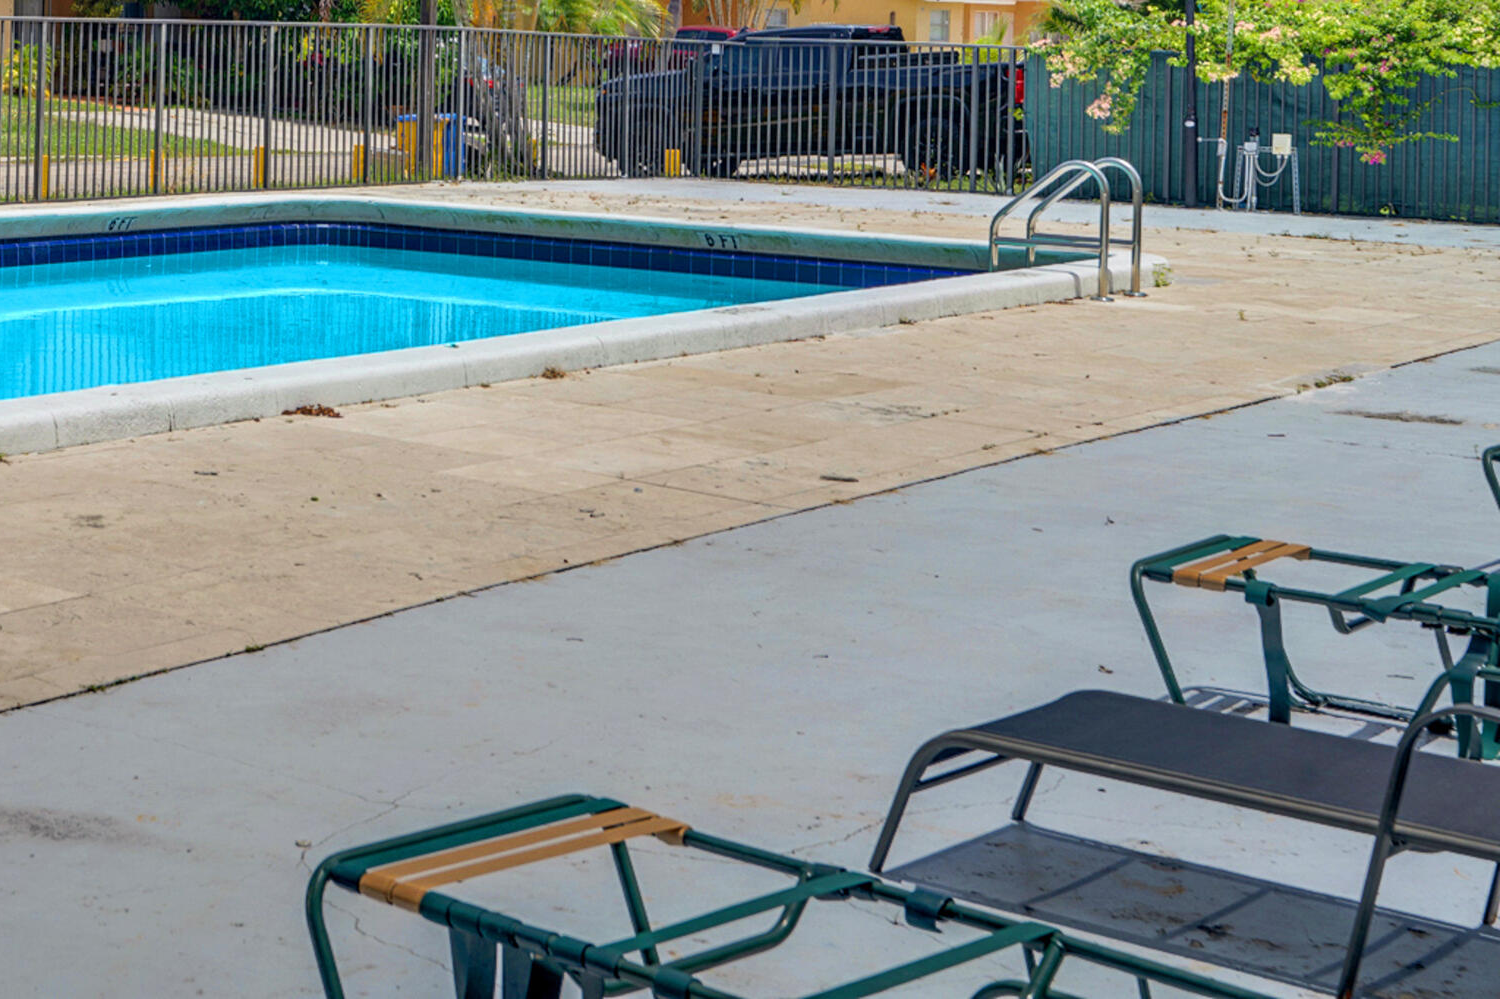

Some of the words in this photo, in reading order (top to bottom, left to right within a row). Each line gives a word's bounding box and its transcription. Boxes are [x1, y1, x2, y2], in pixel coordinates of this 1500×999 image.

[107, 216, 119, 231] 6
[117, 215, 138, 231] FT
[704, 233, 715, 247] 6
